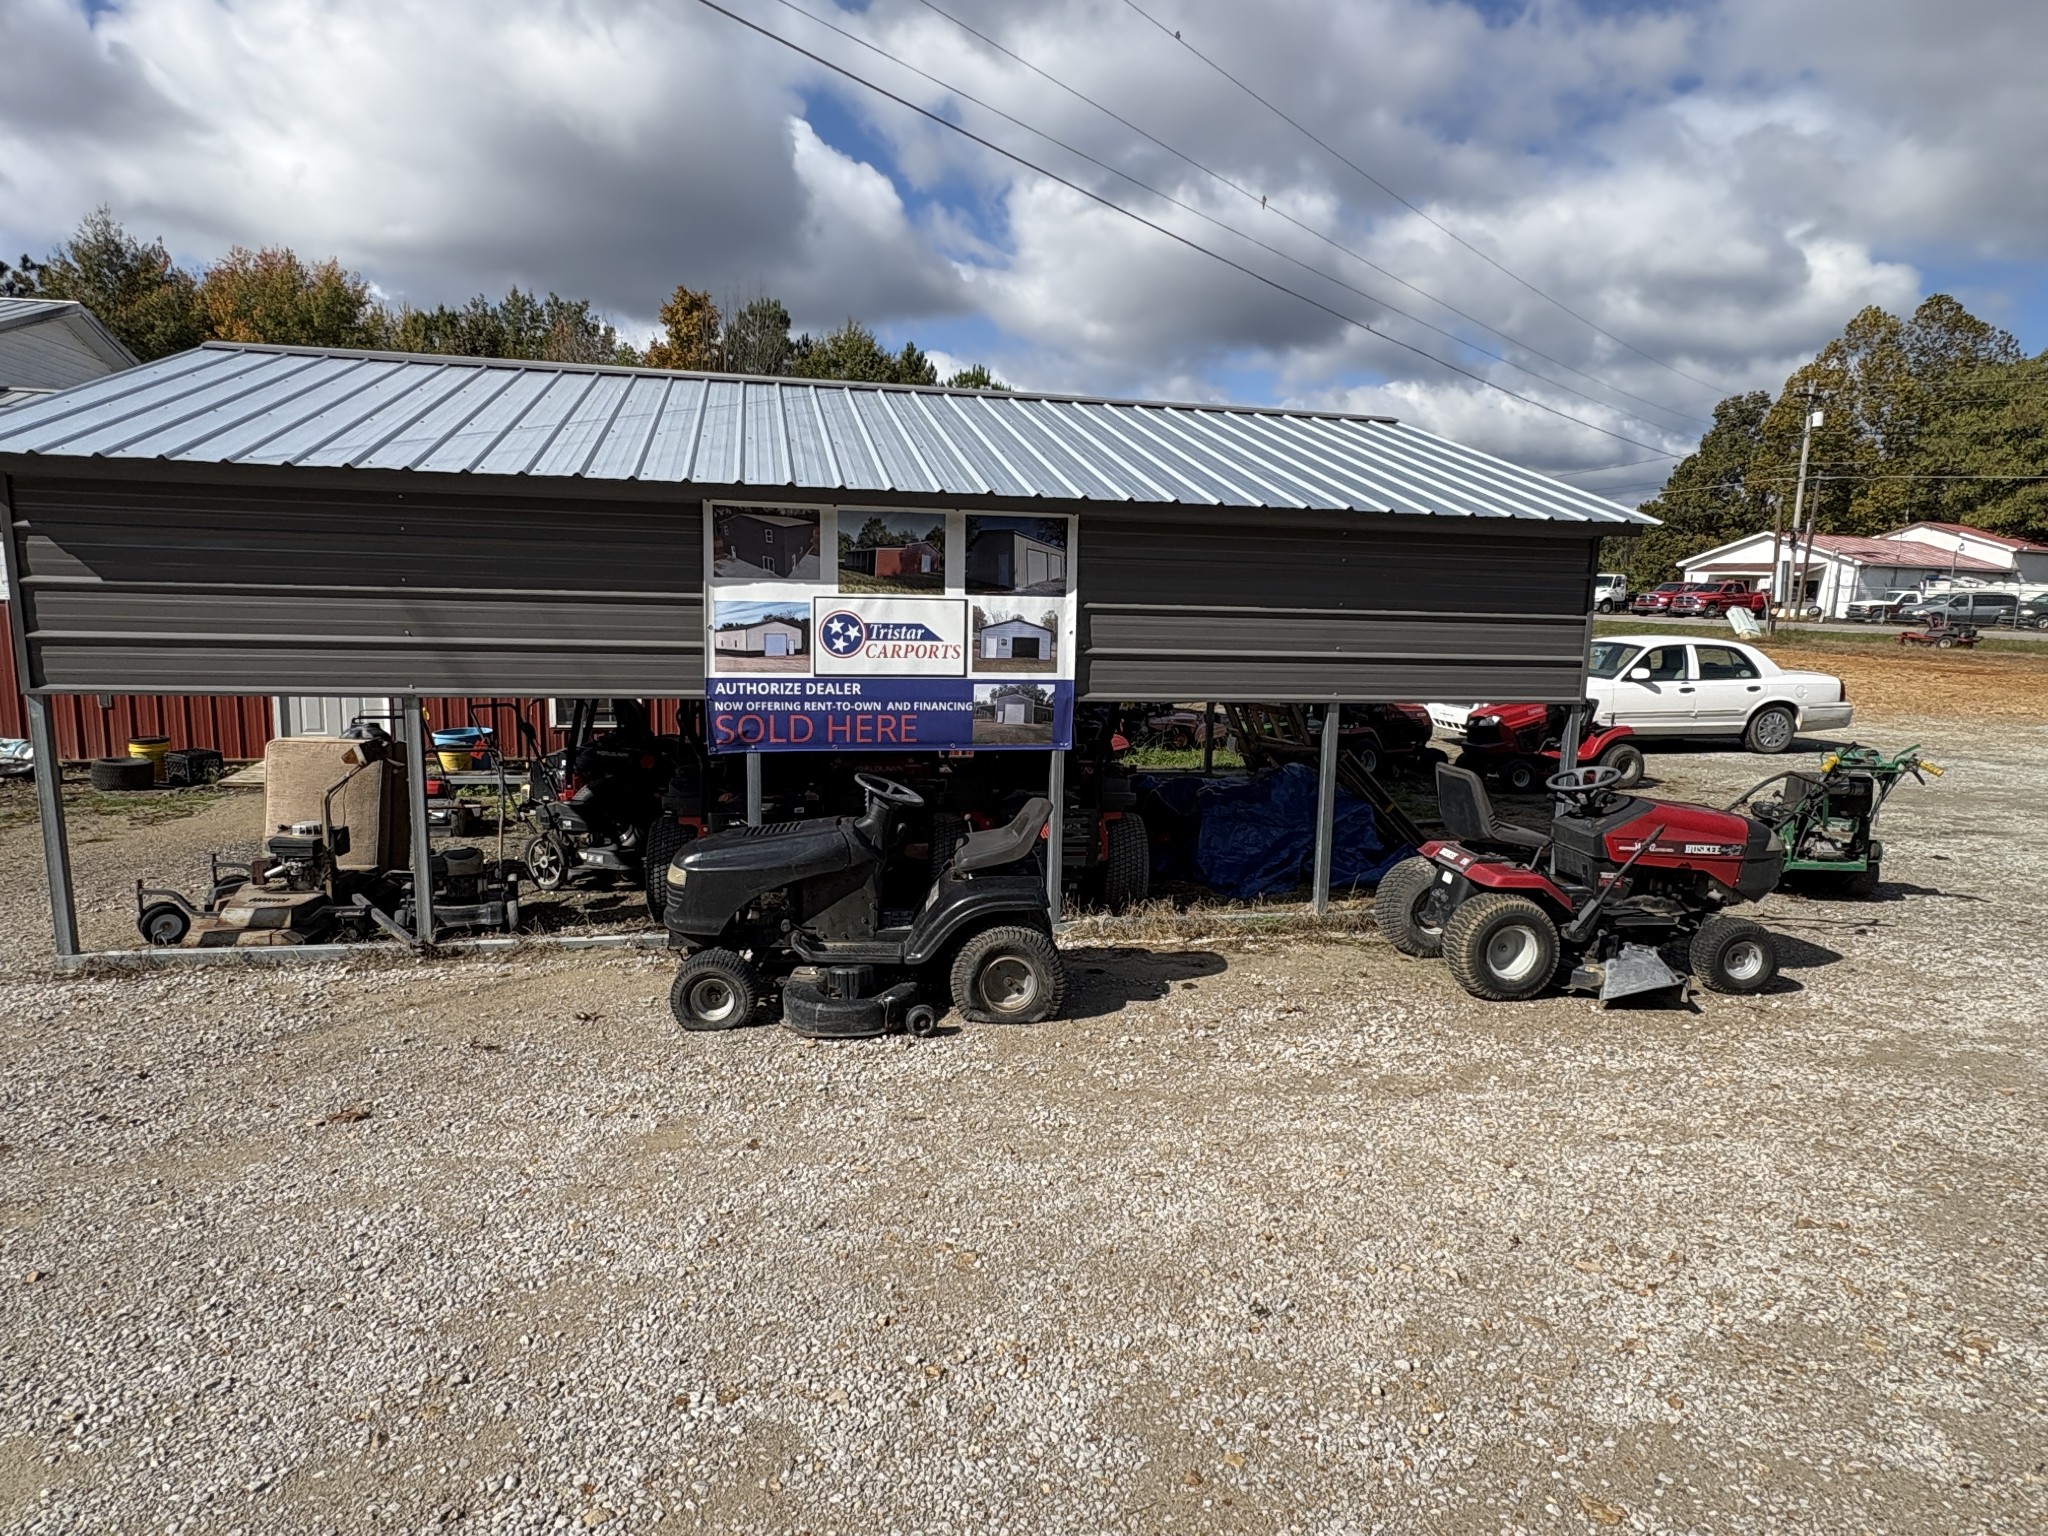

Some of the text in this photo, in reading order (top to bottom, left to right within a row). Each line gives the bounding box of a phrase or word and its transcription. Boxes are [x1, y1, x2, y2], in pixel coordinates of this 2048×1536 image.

[870, 624, 925, 640] Tristar
[865, 643, 962, 660] CARPORTS
[714, 682, 862, 695] AUTHORIZE DEALER
[714, 701, 973, 711] NOW OFFERING RENT-TO-OWN AND FINANCING
[715, 714, 918, 744] SOLD HERE
[1684, 844, 1721, 855] HUSKEE
